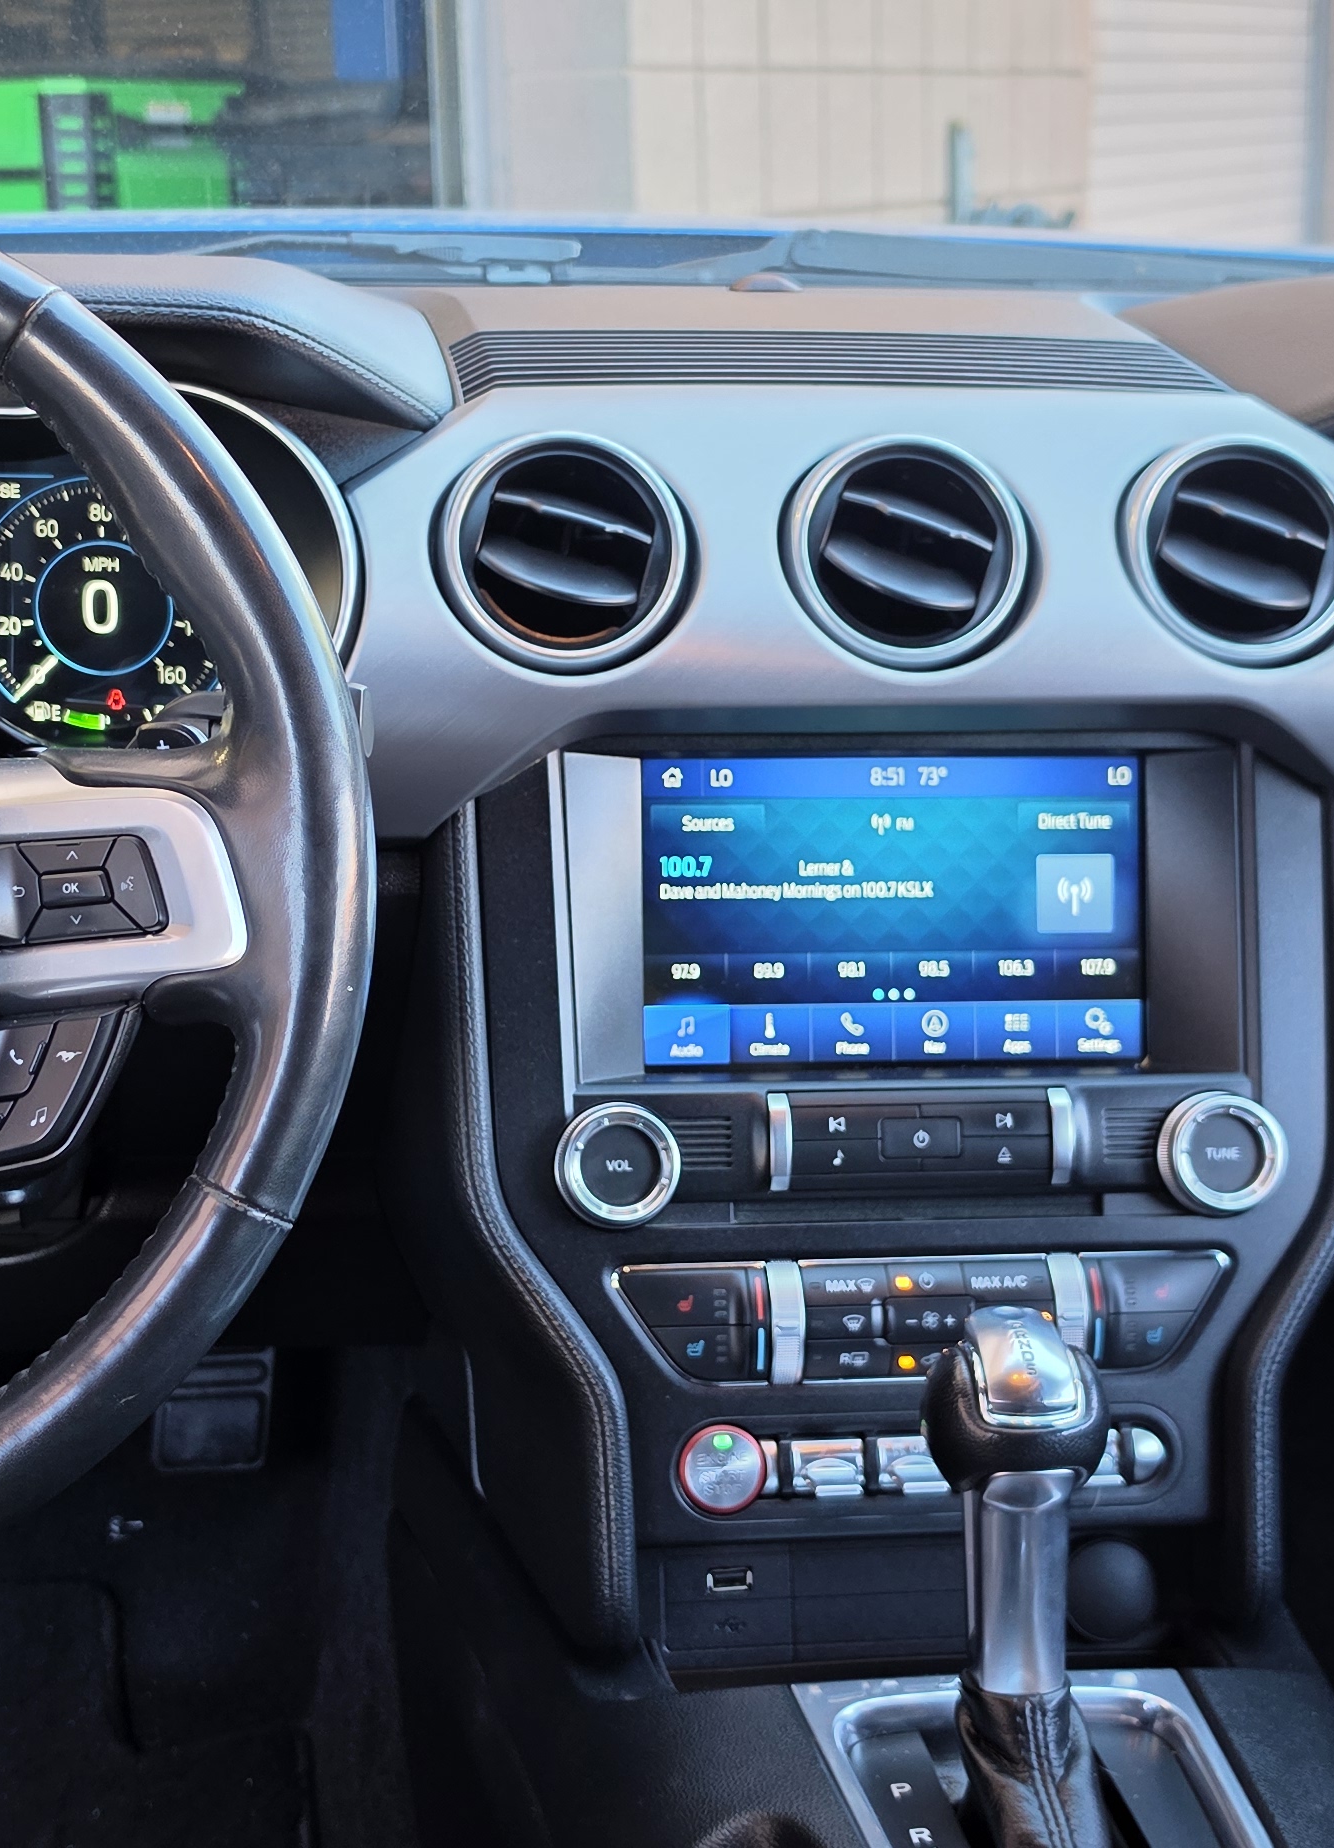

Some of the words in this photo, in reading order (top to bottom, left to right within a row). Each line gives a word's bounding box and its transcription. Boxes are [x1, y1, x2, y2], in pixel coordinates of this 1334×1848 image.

[33, 519, 59, 538] 60
[0, 562, 23, 582] 40
[82, 556, 120, 573] MPH
[81, 579, 119, 635] 0
[156, 665, 187, 684] 160
[50, 704, 62, 722] E
[710, 768, 734, 788] LO
[870, 766, 906, 787] 8:51
[918, 766, 949, 786] 73°
[1107, 766, 1133, 786] LO
[681, 815, 735, 832] Sources
[896, 817, 915, 831] FM
[1037, 812, 1076, 830] Direct
[1078, 812, 1113, 830] Tune
[659, 855, 713, 878] 100.7
[798, 860, 840, 877] Lerner
[841, 859, 854, 877] &
[62, 882, 80, 894] OK
[659, 883, 694, 900] Dave
[694, 882, 721, 899] and
[722, 882, 782, 902] Mahoney
[783, 882, 842, 901] Mornings
[843, 885, 862, 898] on
[861, 881, 897, 898] 100.7
[897, 880, 934, 898] KSLX
[671, 963, 701, 980] 97.9
[998, 959, 1035, 977] 106.3
[1080, 958, 1116, 976] 107.9
[670, 1043, 704, 1058] Audio
[749, 1042, 790, 1056] Climate
[835, 1041, 870, 1056] Phone
[923, 1040, 947, 1054] Nav
[1003, 1039, 1032, 1054] Apps
[1077, 1037, 1122, 1054] Settings
[1205, 1146, 1242, 1161] TUNE
[605, 1159, 633, 1172] VOL
[825, 1279, 857, 1293] MAX
[971, 1275, 1001, 1290] MAX
[1003, 1274, 1029, 1288] A/C
[698, 1469, 747, 1484] START
[890, 1783, 912, 1800] P
[909, 1827, 934, 1847] R
